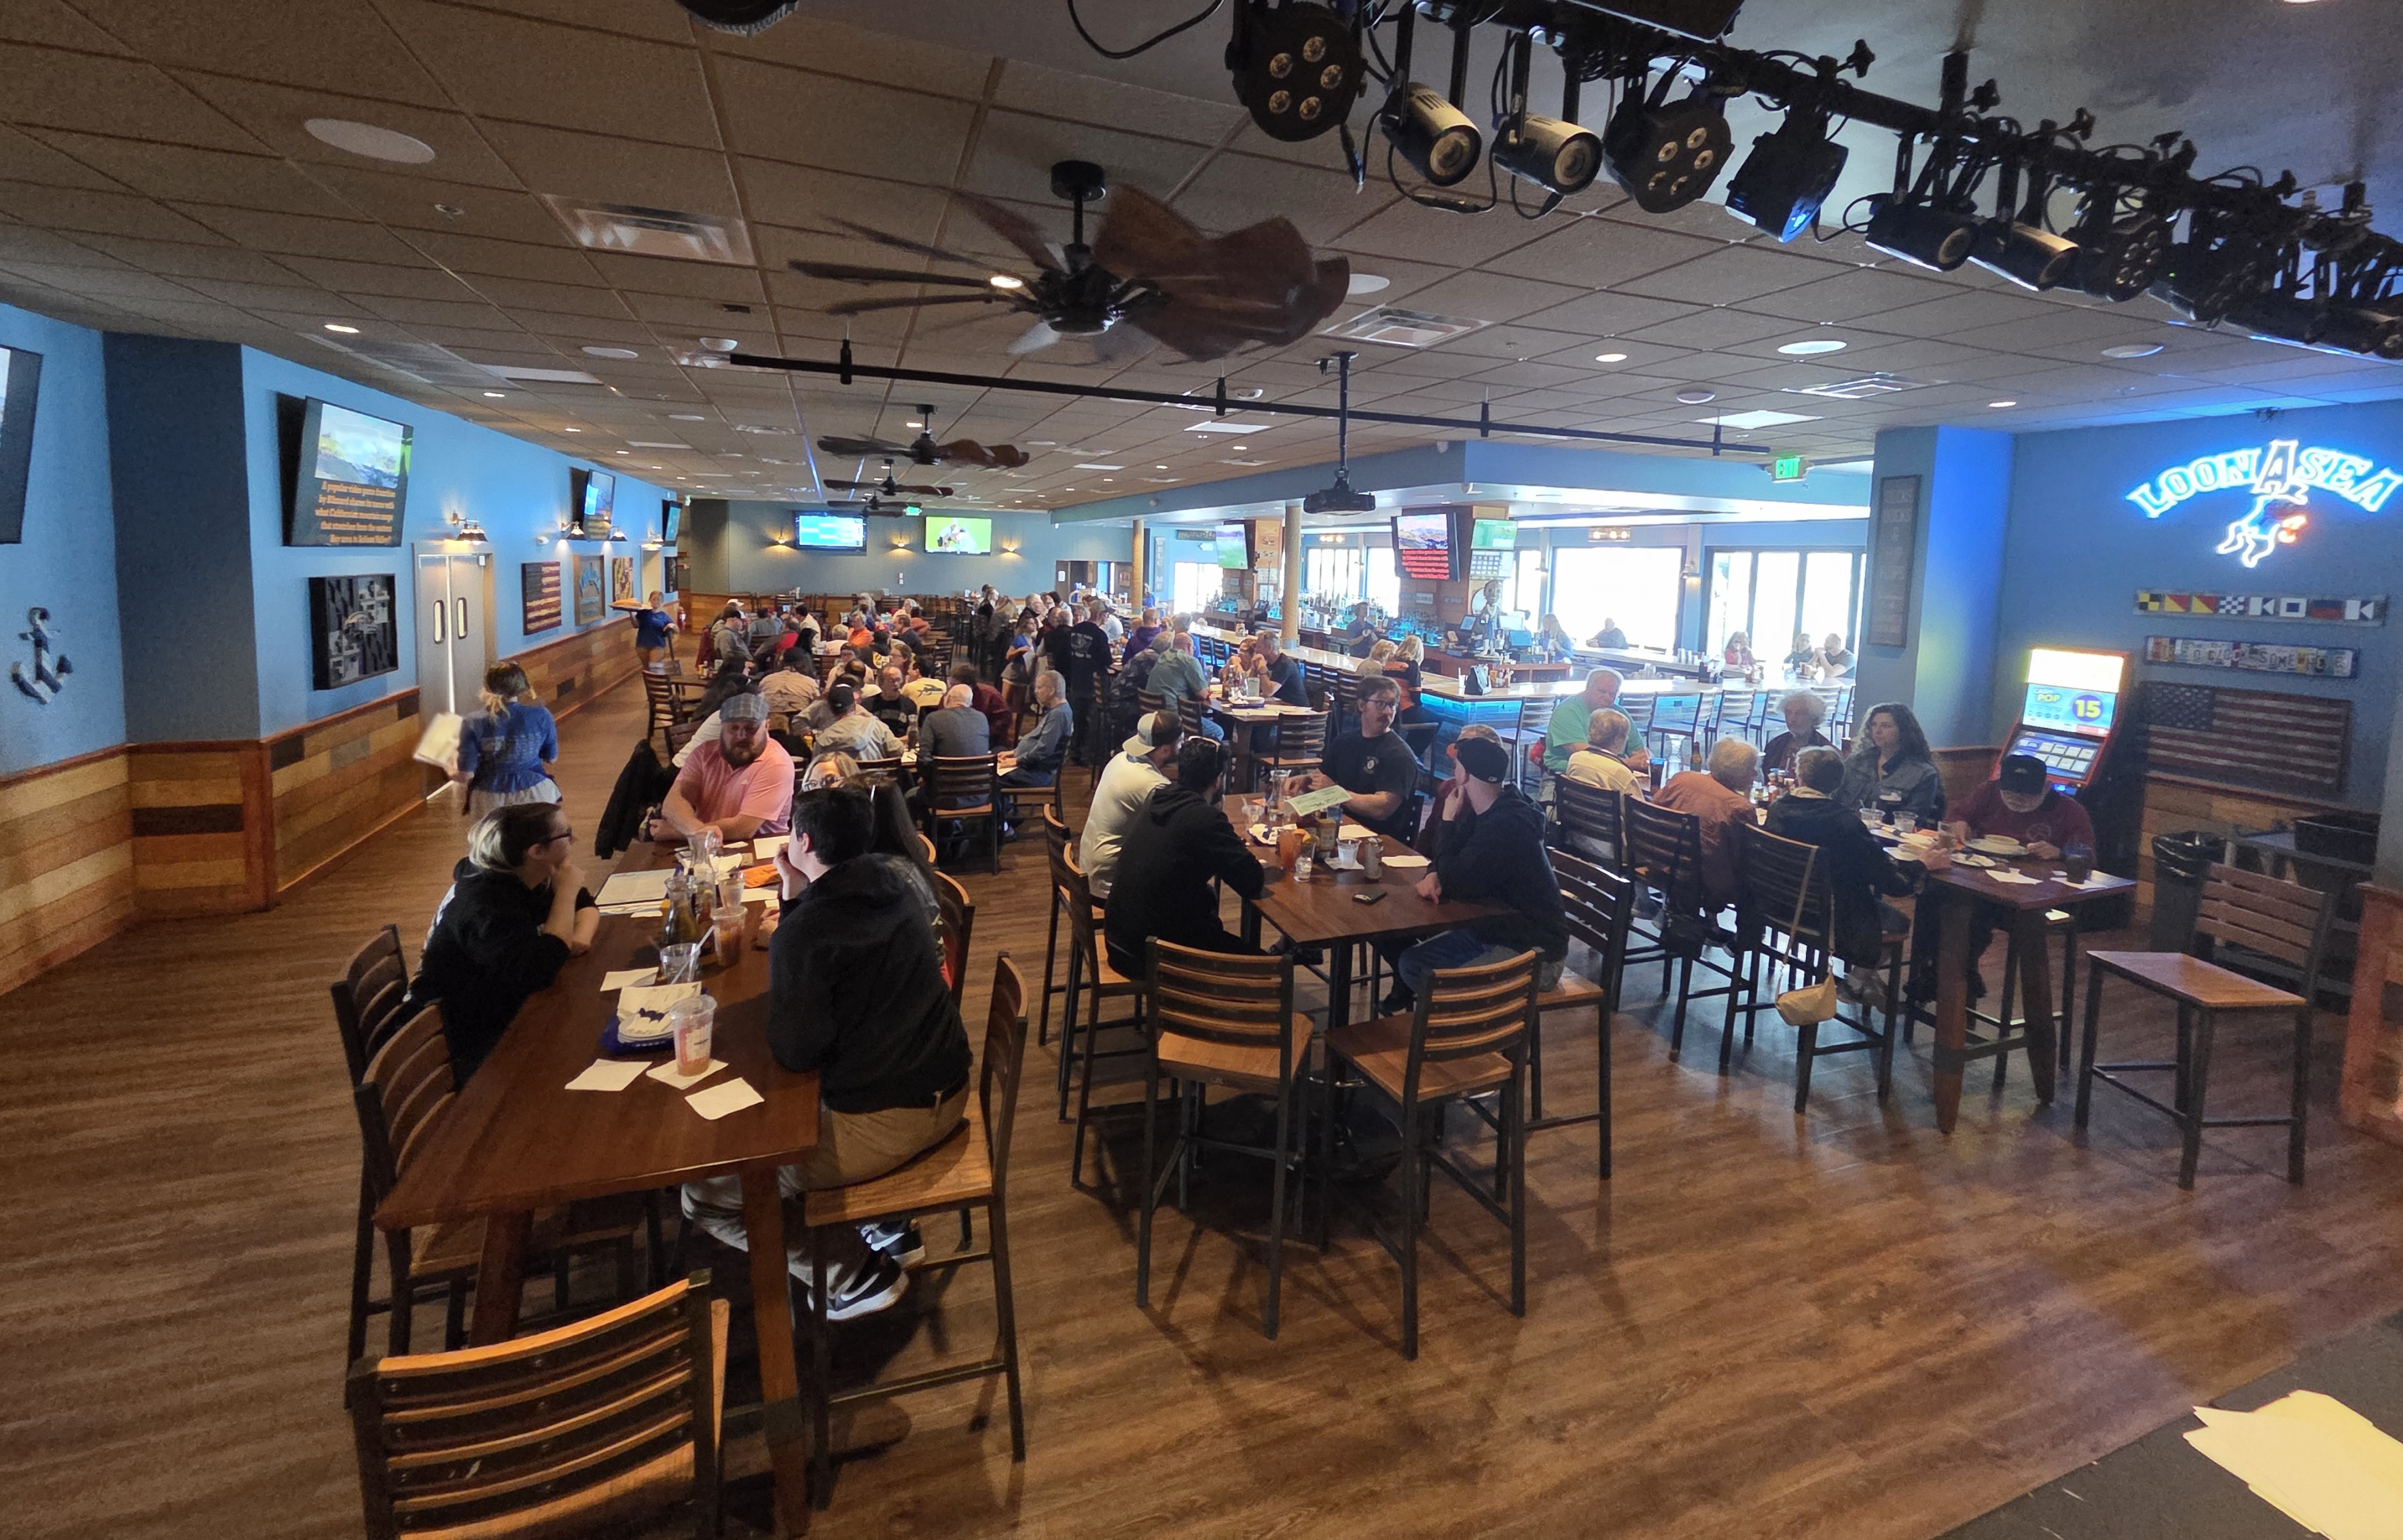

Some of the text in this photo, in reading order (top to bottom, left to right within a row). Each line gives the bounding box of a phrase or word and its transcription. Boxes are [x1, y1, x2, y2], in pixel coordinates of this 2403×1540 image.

[1155, 537, 1166, 590] WELCME
[2036, 693, 2061, 703] POP
[2075, 699, 2101, 718] 15
